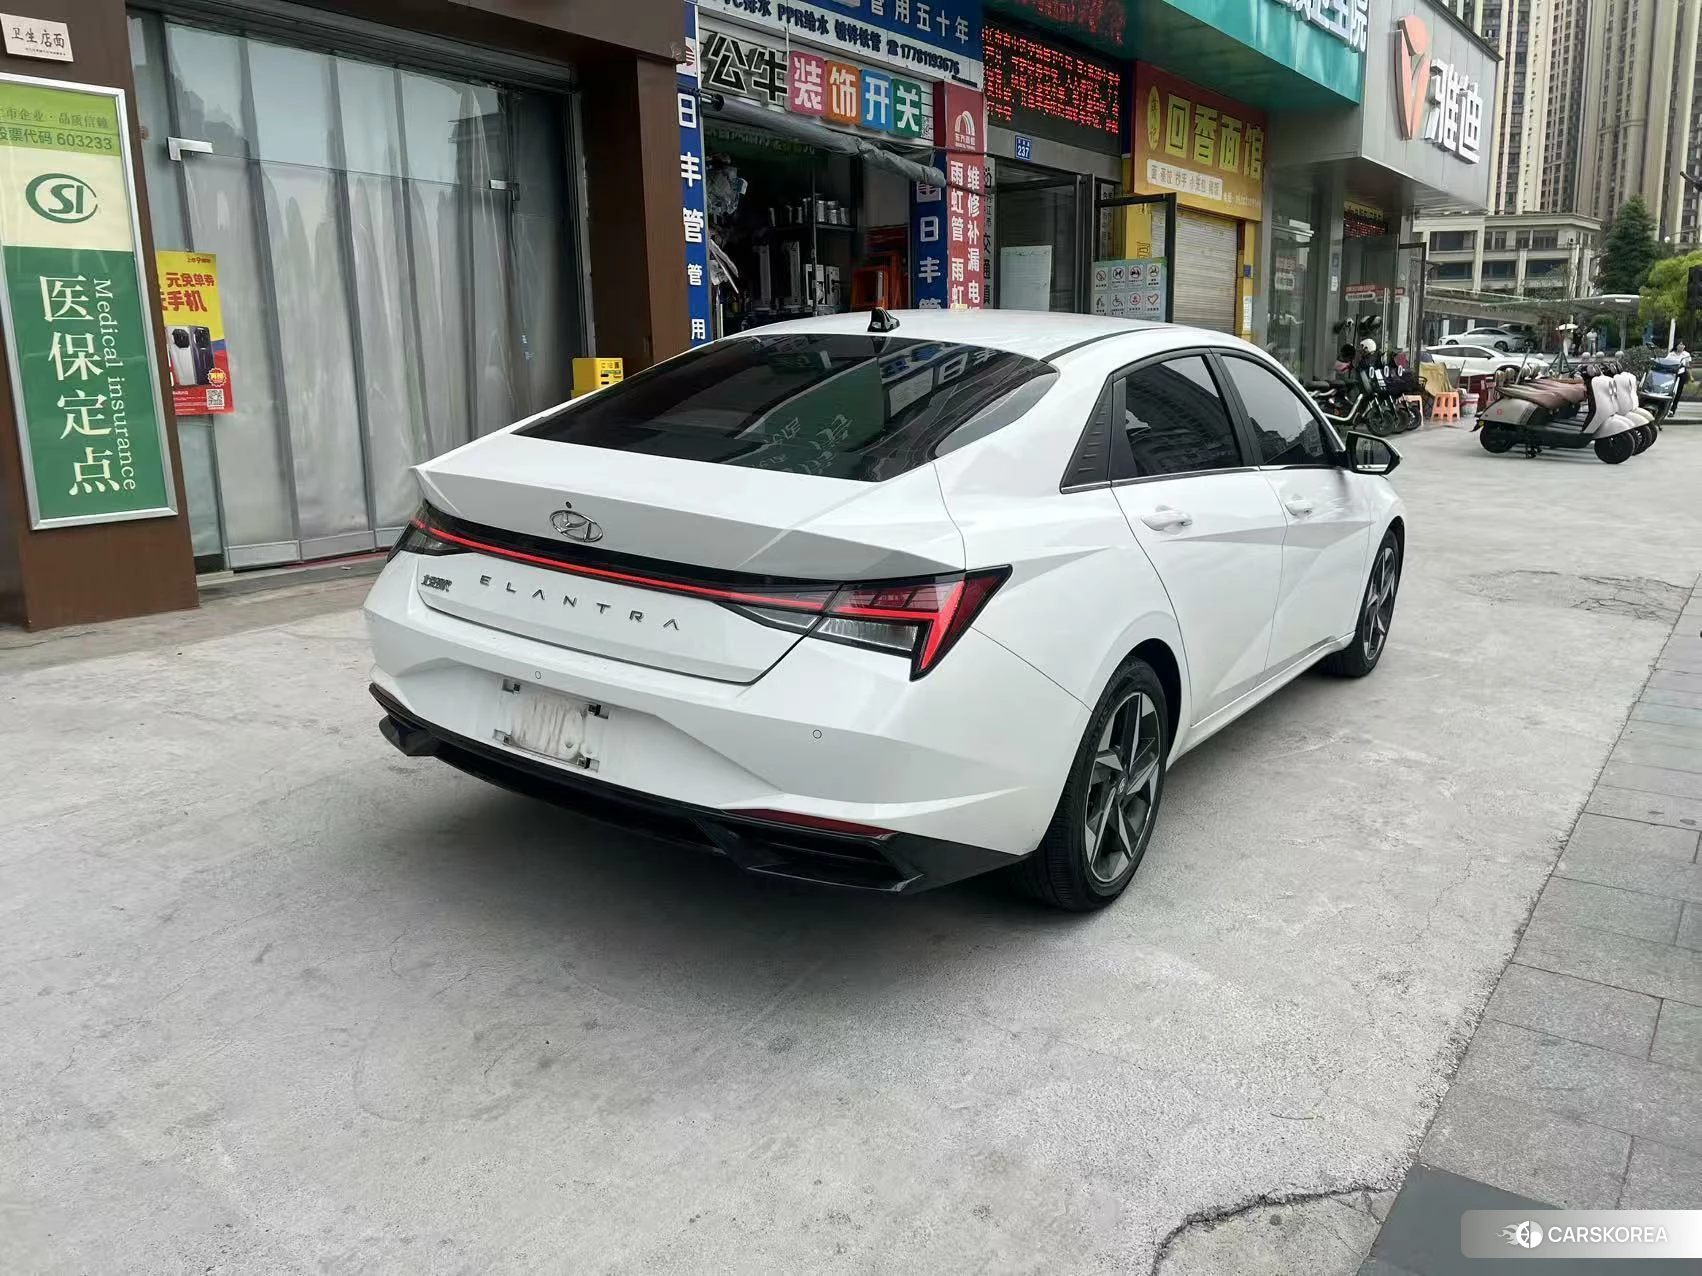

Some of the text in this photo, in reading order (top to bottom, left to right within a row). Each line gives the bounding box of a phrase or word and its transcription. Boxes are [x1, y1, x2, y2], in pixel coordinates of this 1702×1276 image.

[11, 27, 65, 48] 卫生店面
[707, 32, 789, 102] 公牛
[794, 56, 920, 132] 装饰开关
[56, 132, 113, 151] 603233
[1017, 146, 1031, 158] 237
[1424, 58, 1482, 164] 雅迪
[950, 160, 964, 243] 雨虹管
[967, 164, 980, 273] 维修补漏
[39, 275, 121, 496] 医保定点
[93, 277, 136, 491] Medical insurance
[479, 574, 680, 631] ELANTRA
